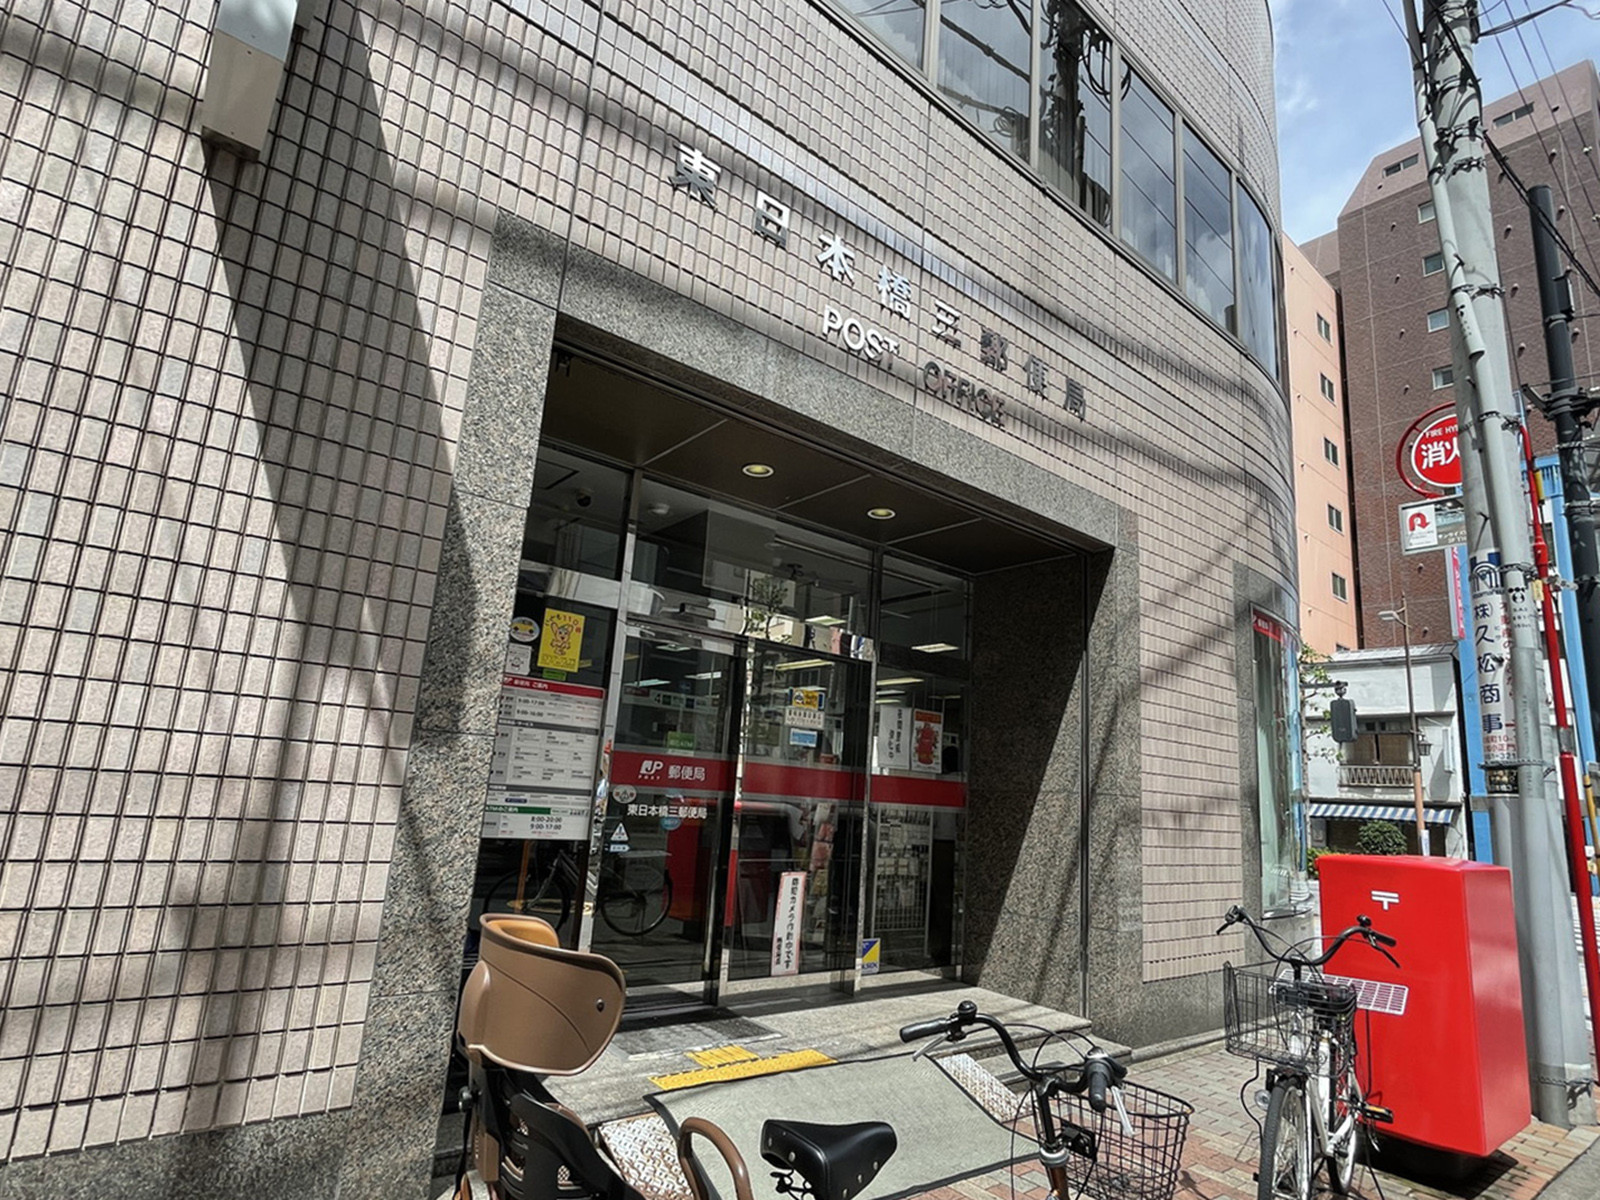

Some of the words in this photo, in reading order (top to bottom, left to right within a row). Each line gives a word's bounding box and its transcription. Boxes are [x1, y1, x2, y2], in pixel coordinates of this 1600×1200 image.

[668, 143, 1087, 421] 東日本橋三郵便局
[821, 304, 901, 370] POST
[921, 360, 1005, 427] OFFICE
[1426, 427, 1443, 438] FIRE
[1474, 602, 1503, 733] 株)久松商事
[668, 765, 706, 781] 郵便局
[627, 803, 708, 819] 東日本橋三郵便局
